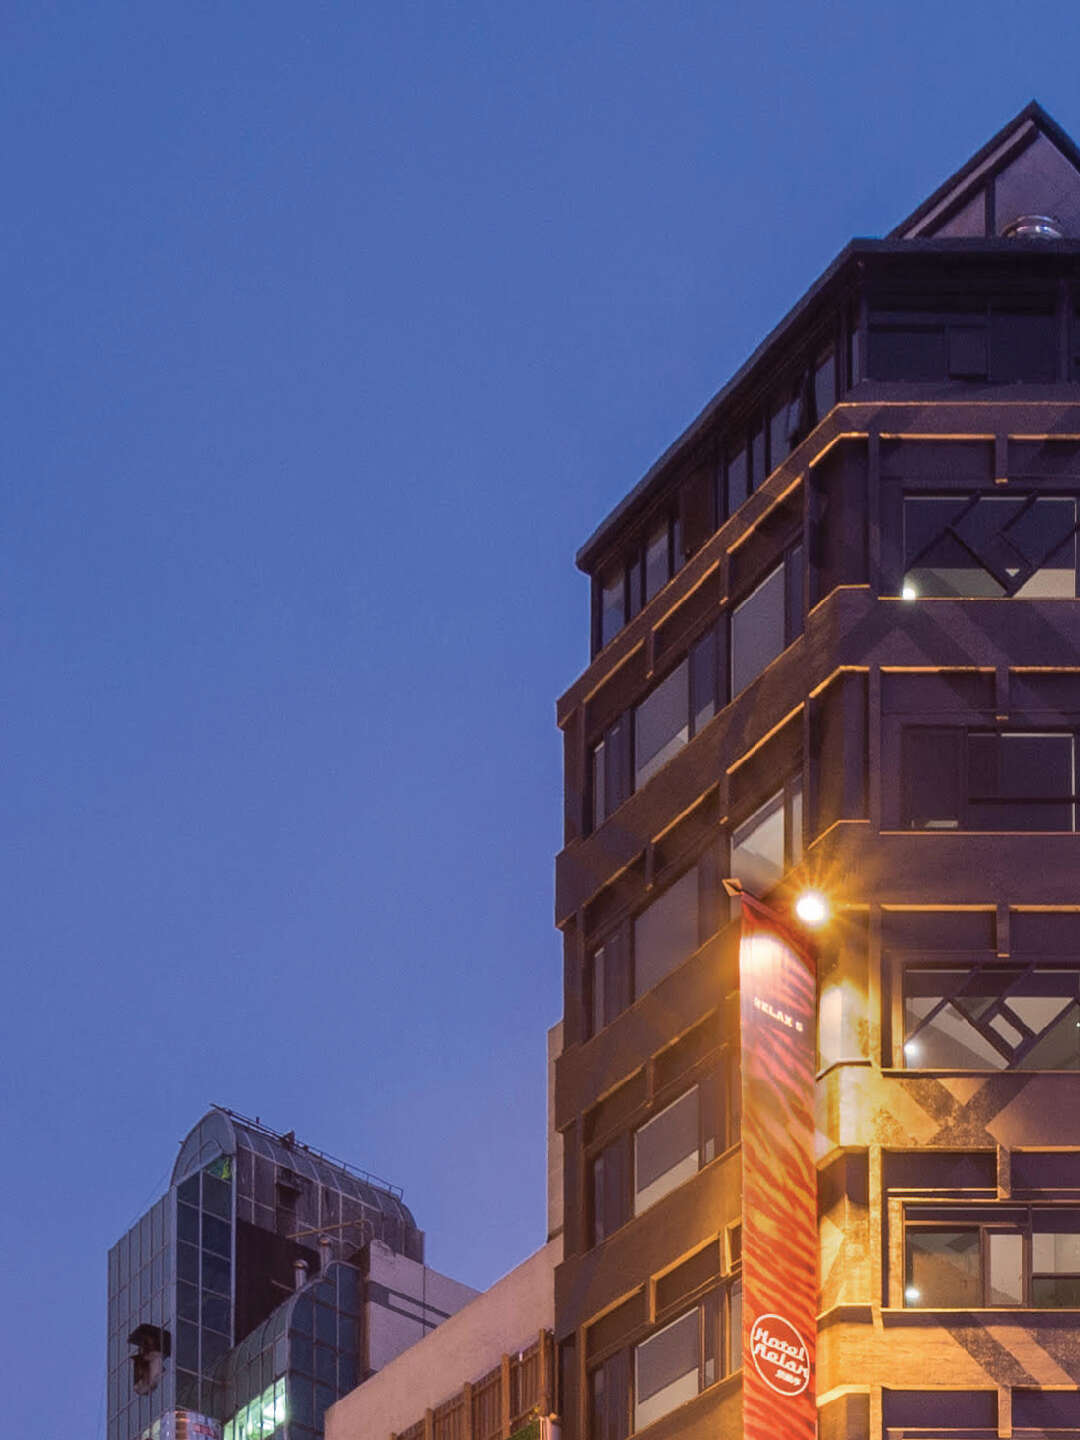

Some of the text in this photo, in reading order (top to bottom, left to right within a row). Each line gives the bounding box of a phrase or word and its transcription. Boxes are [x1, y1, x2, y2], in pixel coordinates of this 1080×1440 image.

[754, 996, 793, 1028] RELAX
[753, 1327, 805, 1362] Hotel
[753, 1343, 809, 1378] Relax
